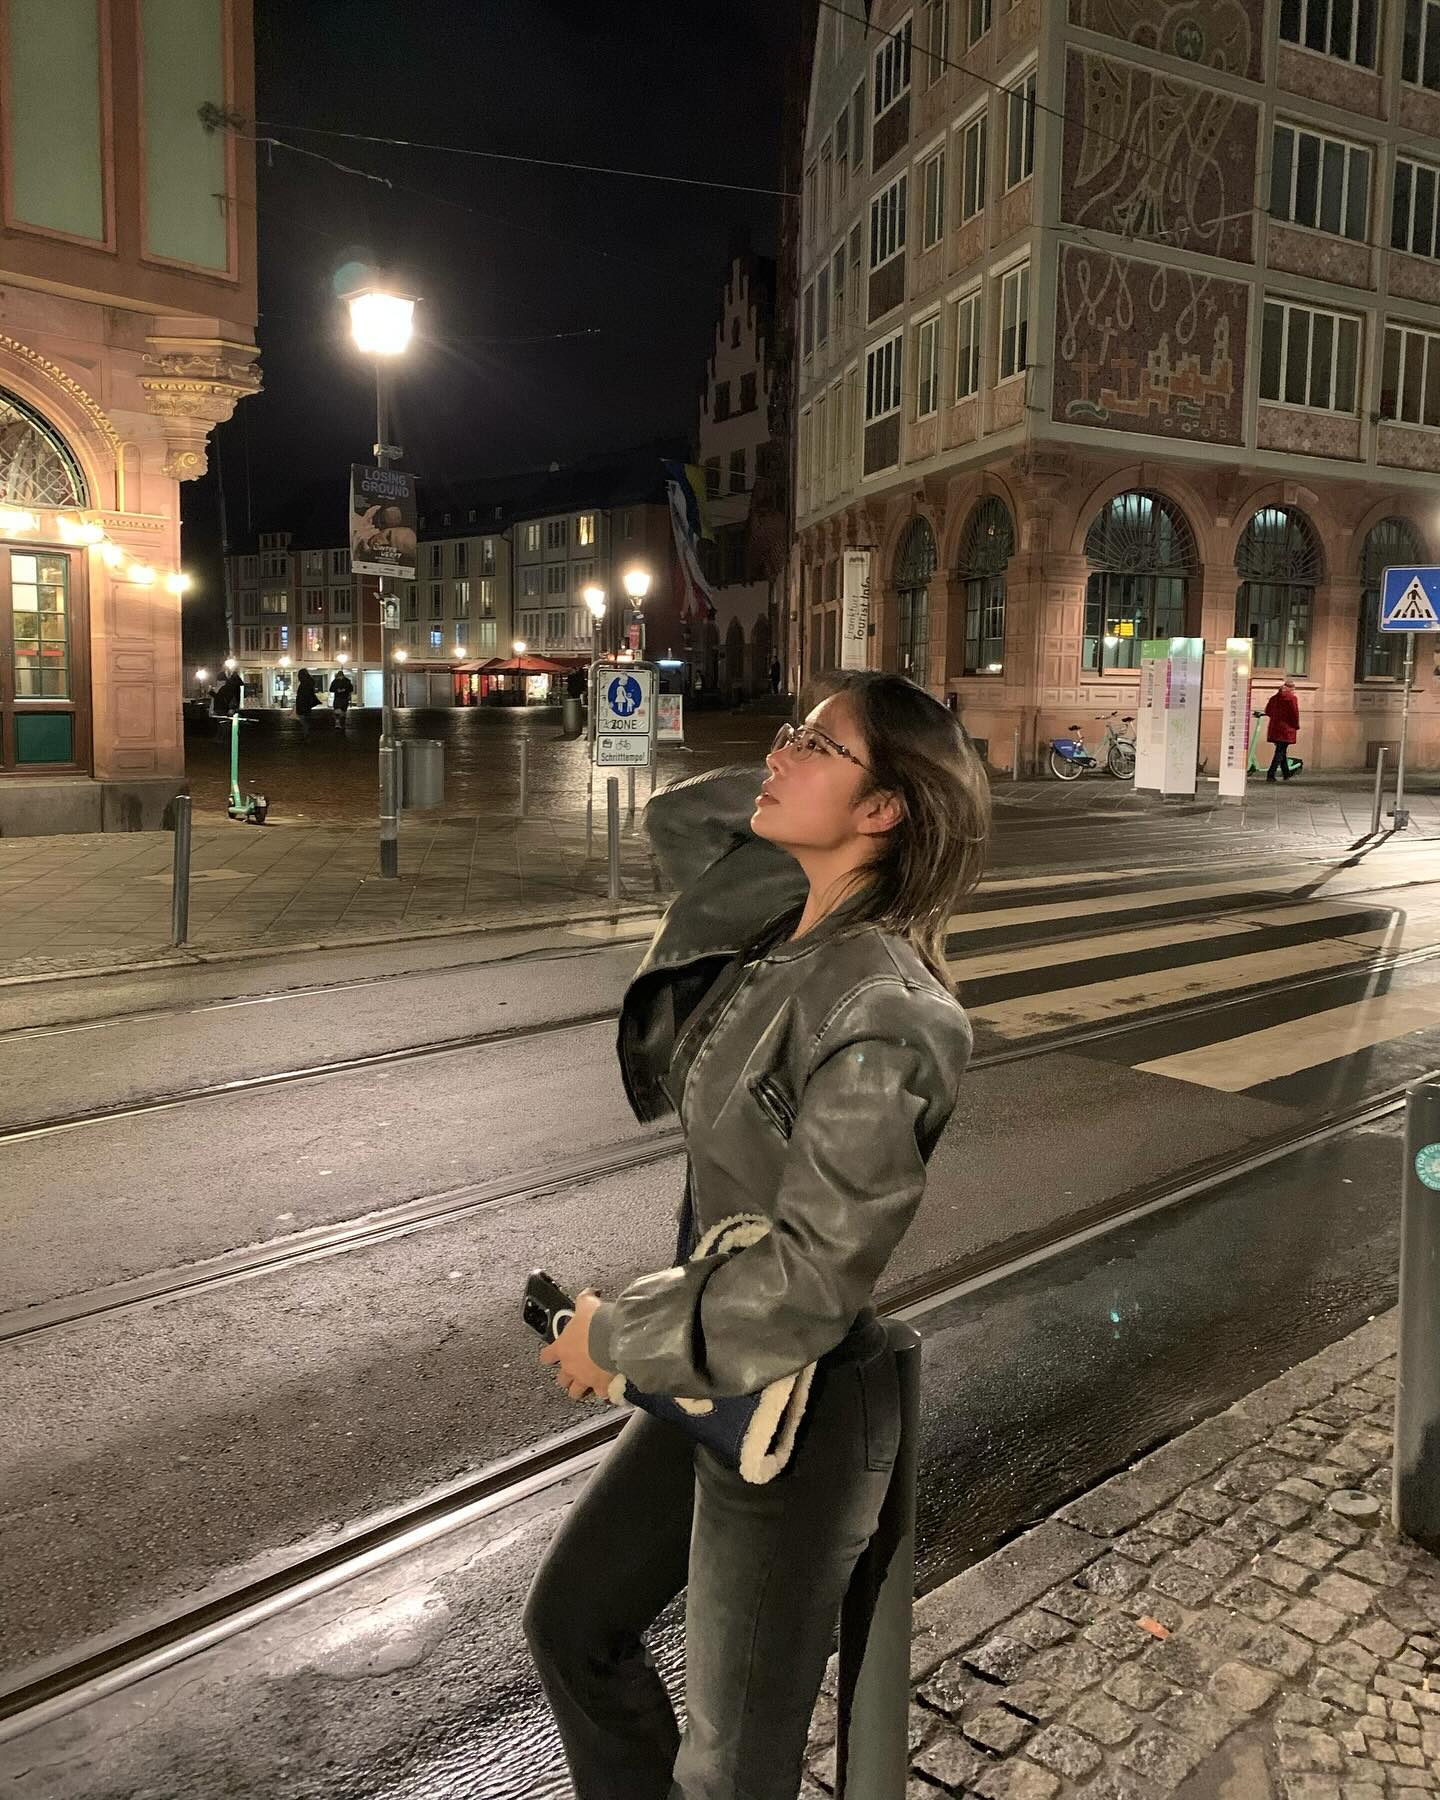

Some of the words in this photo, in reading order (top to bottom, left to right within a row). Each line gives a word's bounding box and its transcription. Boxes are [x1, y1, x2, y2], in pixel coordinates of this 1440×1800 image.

[365, 469, 406, 486] LOSING
[362, 480, 409, 498] GROUND
[853, 604, 868, 640] Tourist
[611, 719, 637, 730] ZONE
